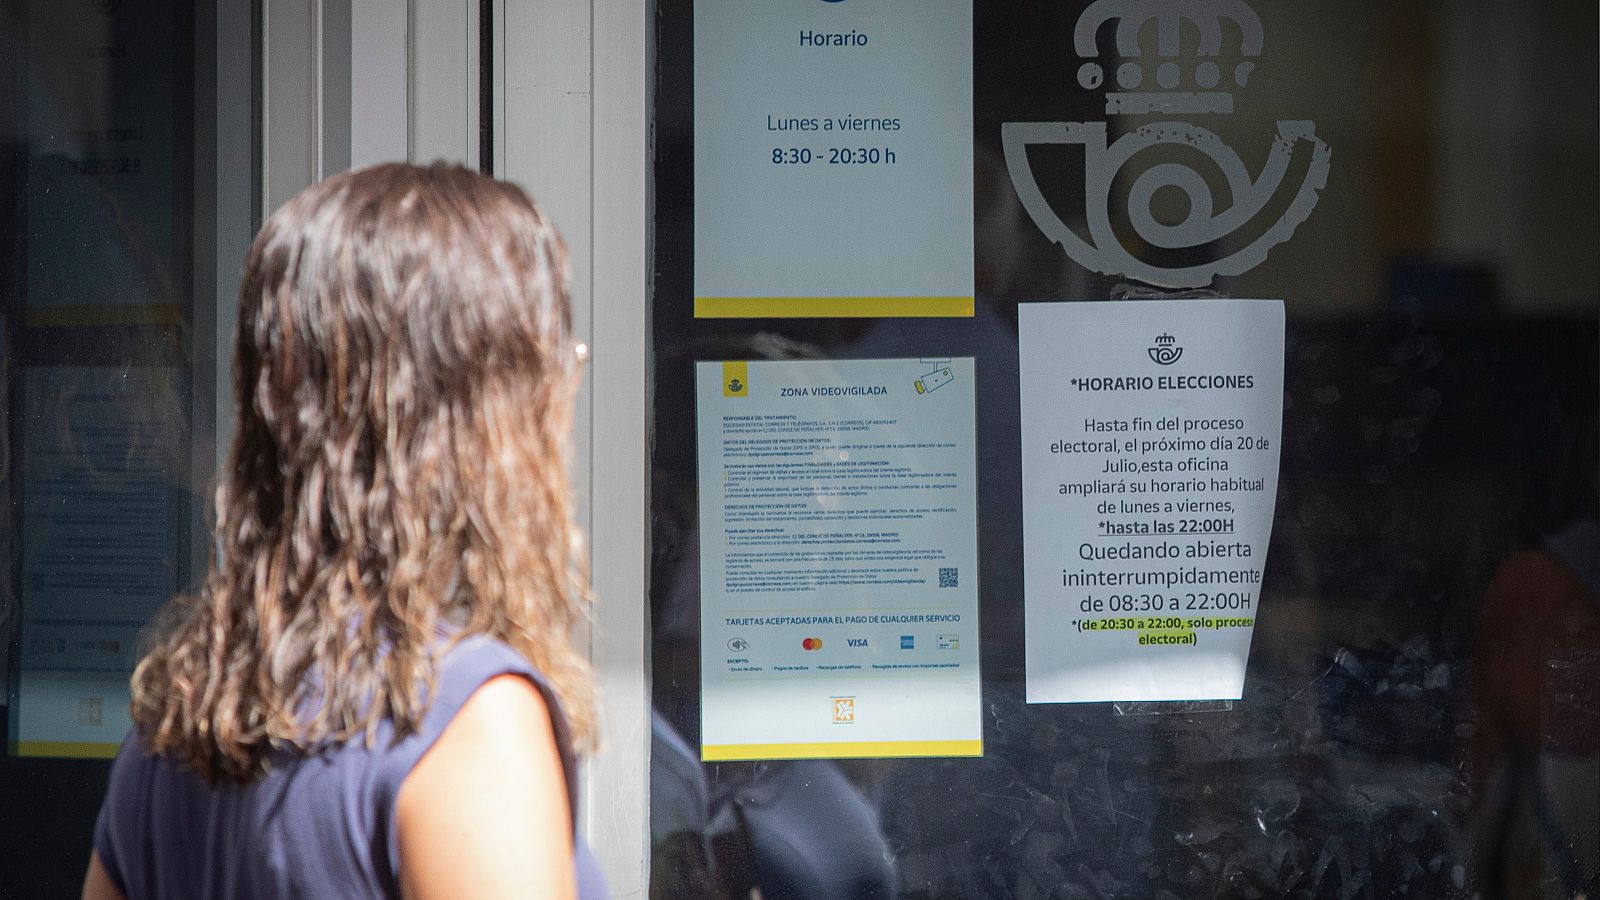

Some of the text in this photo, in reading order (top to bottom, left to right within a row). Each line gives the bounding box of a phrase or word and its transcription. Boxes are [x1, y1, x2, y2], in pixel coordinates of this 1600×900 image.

[800, 30, 868, 46] Horario
[768, 114, 900, 131] Lunes a viernes
[772, 148, 811, 164] 8:30
[830, 148, 880, 164] 20:30
[886, 148, 895, 164] h
[1158, 376, 1253, 390] ELECCIONES
[781, 387, 887, 397] ZONA VIDEOVIGILADA
[1085, 417, 1243, 434] Hasta fin del proceso
[1051, 436, 1269, 455] electoral, el próximo día 20 de
[1102, 457, 1228, 475] Julio,esta oficina
[1059, 477, 1263, 497] ampliará su horario habitual
[1098, 500, 1234, 514] de lunes a viernes,
[1153, 520, 1175, 533] las
[1179, 520, 1234, 533] 22:00H
[1080, 541, 1251, 561] Quedando abierta
[1063, 566, 1260, 588] ininterrumpidamente
[1080, 594, 1250, 612] de 08:30 a 22:00H
[726, 618, 764, 626] TARJETAS
[766, 617, 811, 625] ACEPTADAS
[813, 616, 834, 624] PARA
[835, 616, 844, 624] EL
[846, 616, 868, 624] PAGO
[869, 616, 879, 624] DE
[880, 615, 924, 623] CUALQUIER
[1101, 619, 1134, 630] 20:30
[1138, 621, 1144, 629] a
[1148, 618, 1184, 630] 22:00,
[1187, 617, 1212, 628] solo
[847, 639, 868, 647] VISA
[1139, 632, 1197, 646] electoral)
